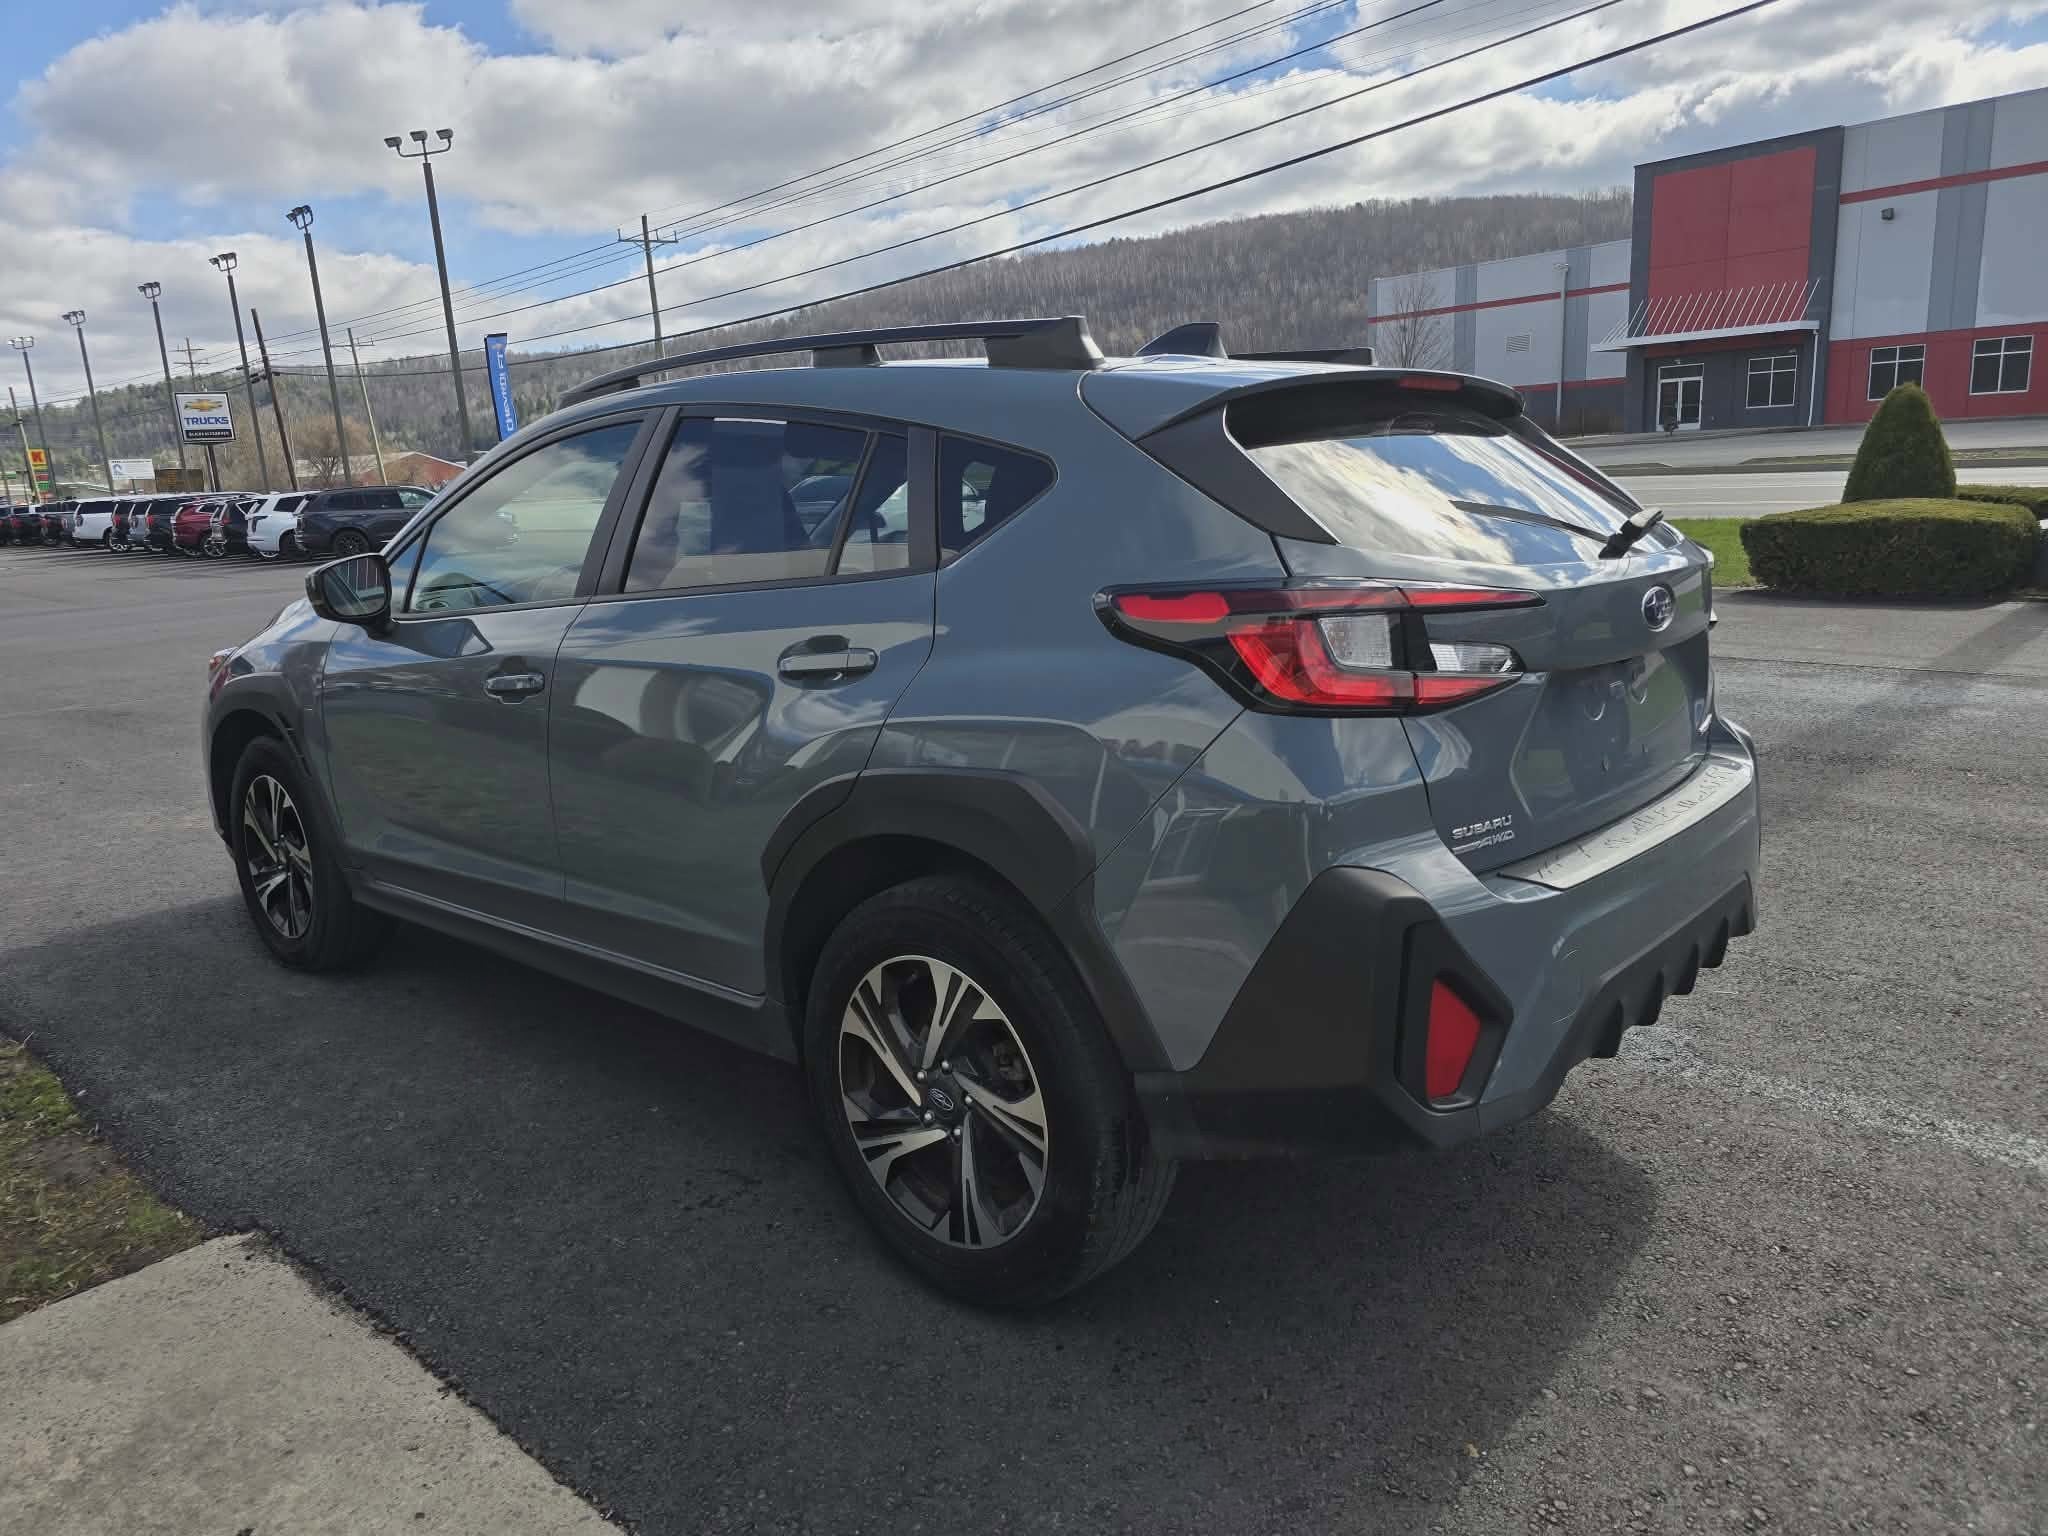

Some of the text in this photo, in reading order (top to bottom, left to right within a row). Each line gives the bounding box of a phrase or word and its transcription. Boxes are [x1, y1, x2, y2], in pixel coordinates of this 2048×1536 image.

[183, 416, 229, 425] TRUCKS
[1452, 815, 1512, 839] SUBARU
[1480, 830, 1515, 848] AWD
